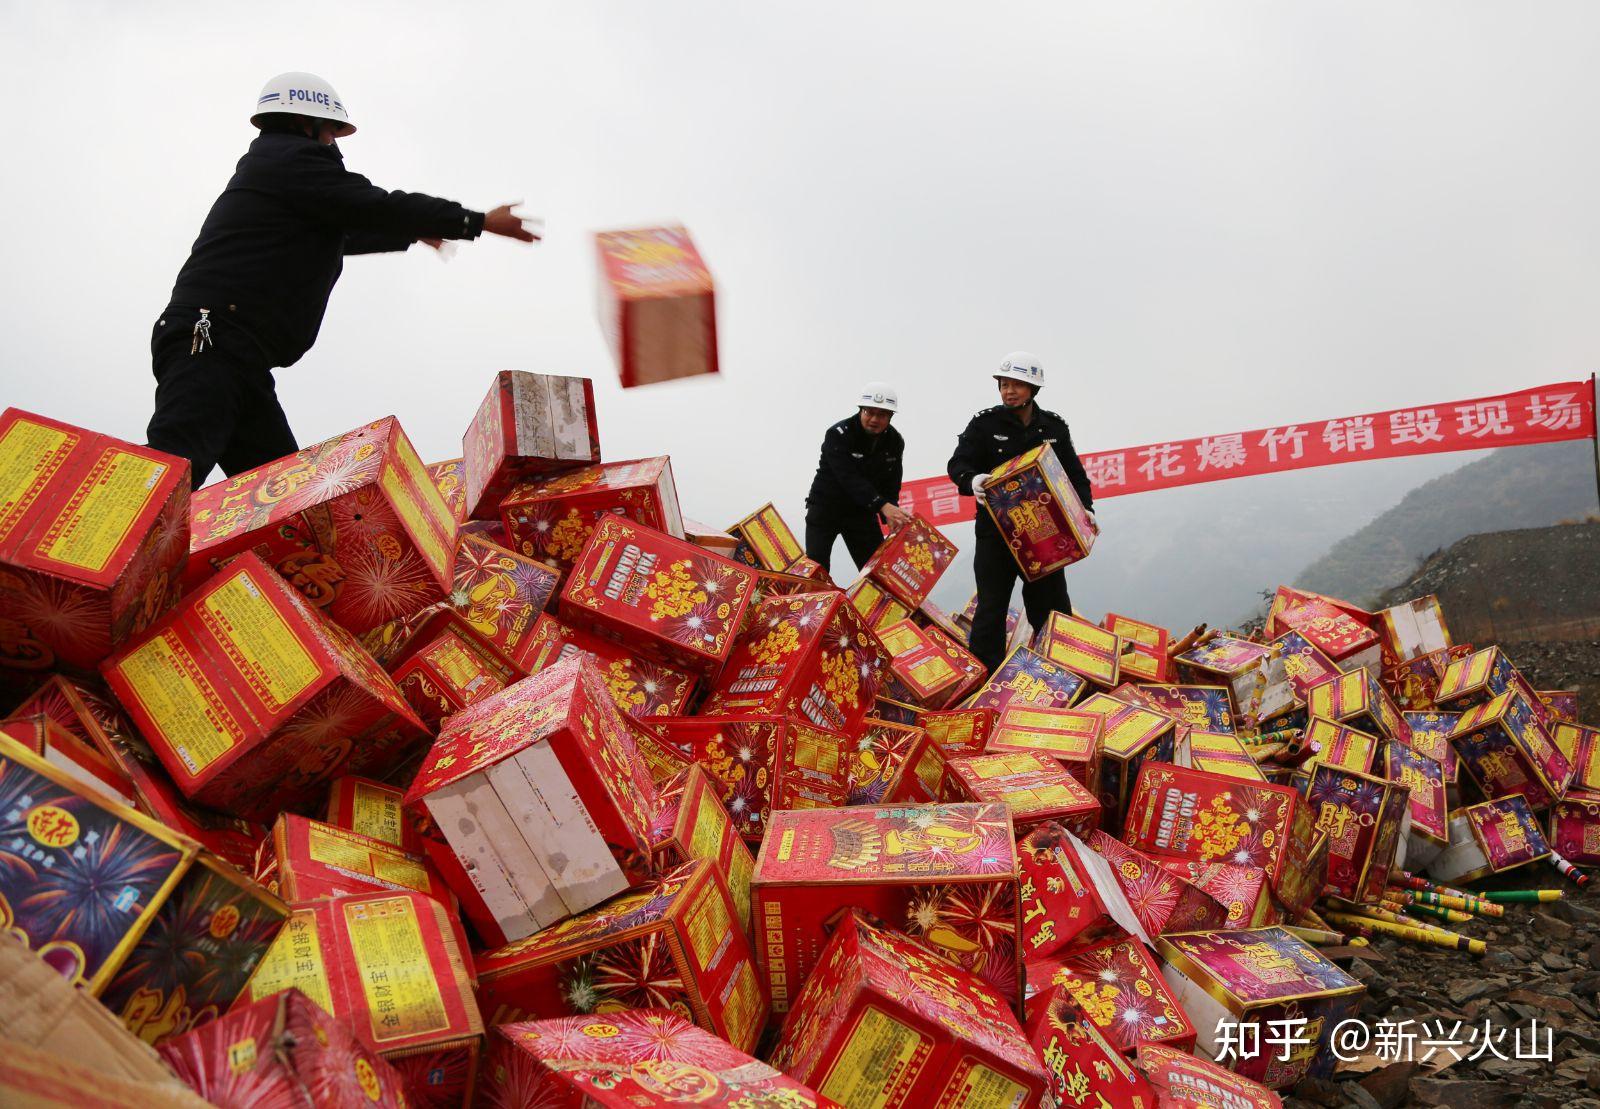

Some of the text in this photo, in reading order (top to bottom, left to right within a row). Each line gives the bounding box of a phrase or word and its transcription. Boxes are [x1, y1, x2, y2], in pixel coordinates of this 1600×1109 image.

[289, 89, 330, 106] POLICE
[728, 680, 779, 693] QIANSHU
[808, 683, 827, 709] YAO
[1180, 793, 1197, 817] YAO
[1155, 788, 1181, 848] QIANSHU
